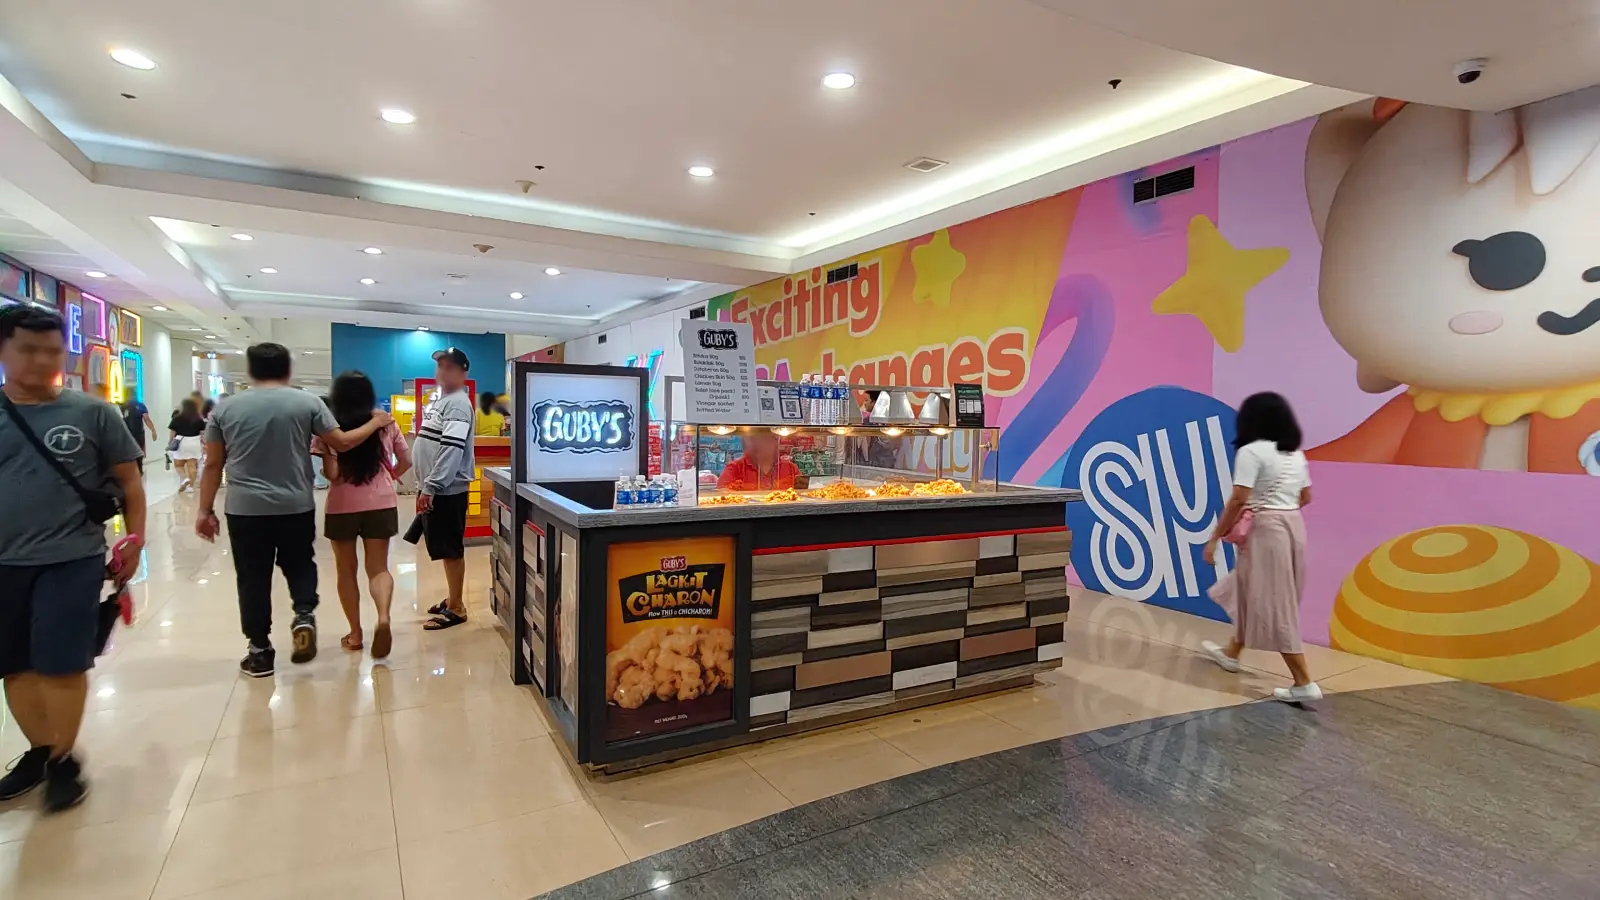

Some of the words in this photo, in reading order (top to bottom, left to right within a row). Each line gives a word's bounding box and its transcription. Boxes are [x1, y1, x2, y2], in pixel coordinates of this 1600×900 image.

[703, 331, 735, 347] GUBY'S
[543, 406, 626, 445] GUBY'S
[662, 558, 685, 570] GUBY'S
[626, 589, 716, 616] CHARON
[661, 609, 673, 617] THIS
